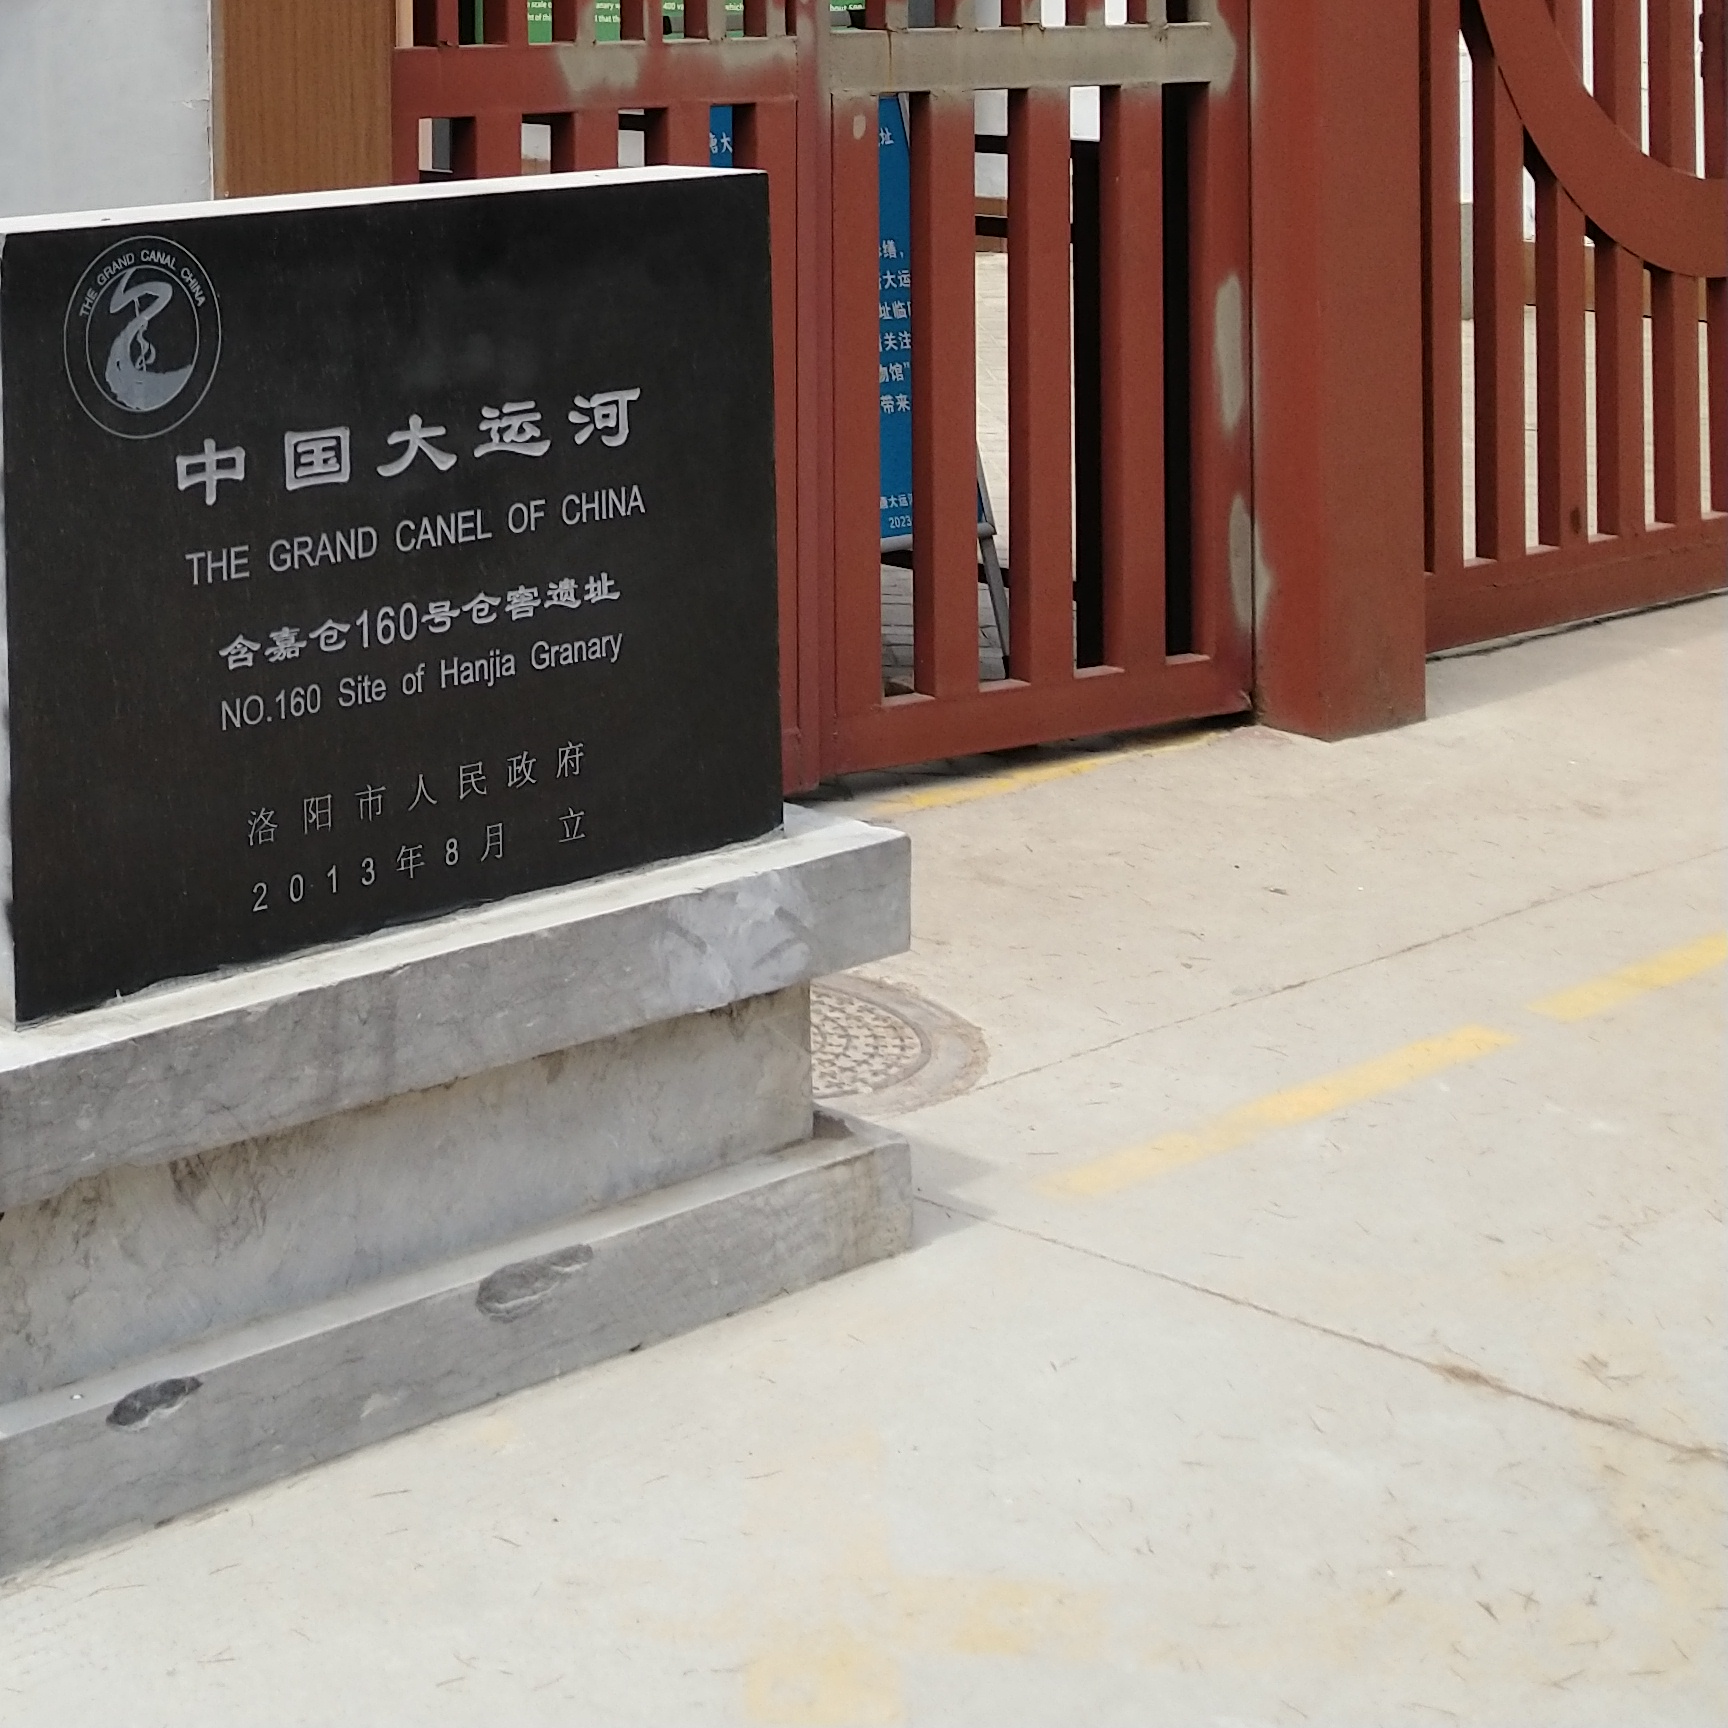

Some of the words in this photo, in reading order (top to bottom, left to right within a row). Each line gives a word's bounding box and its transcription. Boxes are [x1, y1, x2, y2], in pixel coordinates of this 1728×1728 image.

[79, 288, 98, 317] THE
[97, 252, 135, 286] GRAND
[140, 249, 177, 270] CANAL
[180, 267, 206, 307] CHINA
[175, 387, 641, 506] 中国大运河
[185, 544, 250, 585] THE
[269, 524, 378, 574] GRAND
[394, 507, 494, 553] CANEL
[507, 499, 547, 535] OF
[561, 484, 647, 525] CHINA
[219, 572, 622, 671] 含嘉仓160号仓窖遗址
[220, 682, 322, 731] NO.160
[338, 674, 387, 709] Site
[402, 666, 424, 696] of
[440, 649, 517, 691] Hanjia
[531, 632, 624, 672] Granary
[246, 740, 585, 847] 洛阳市人民政府
